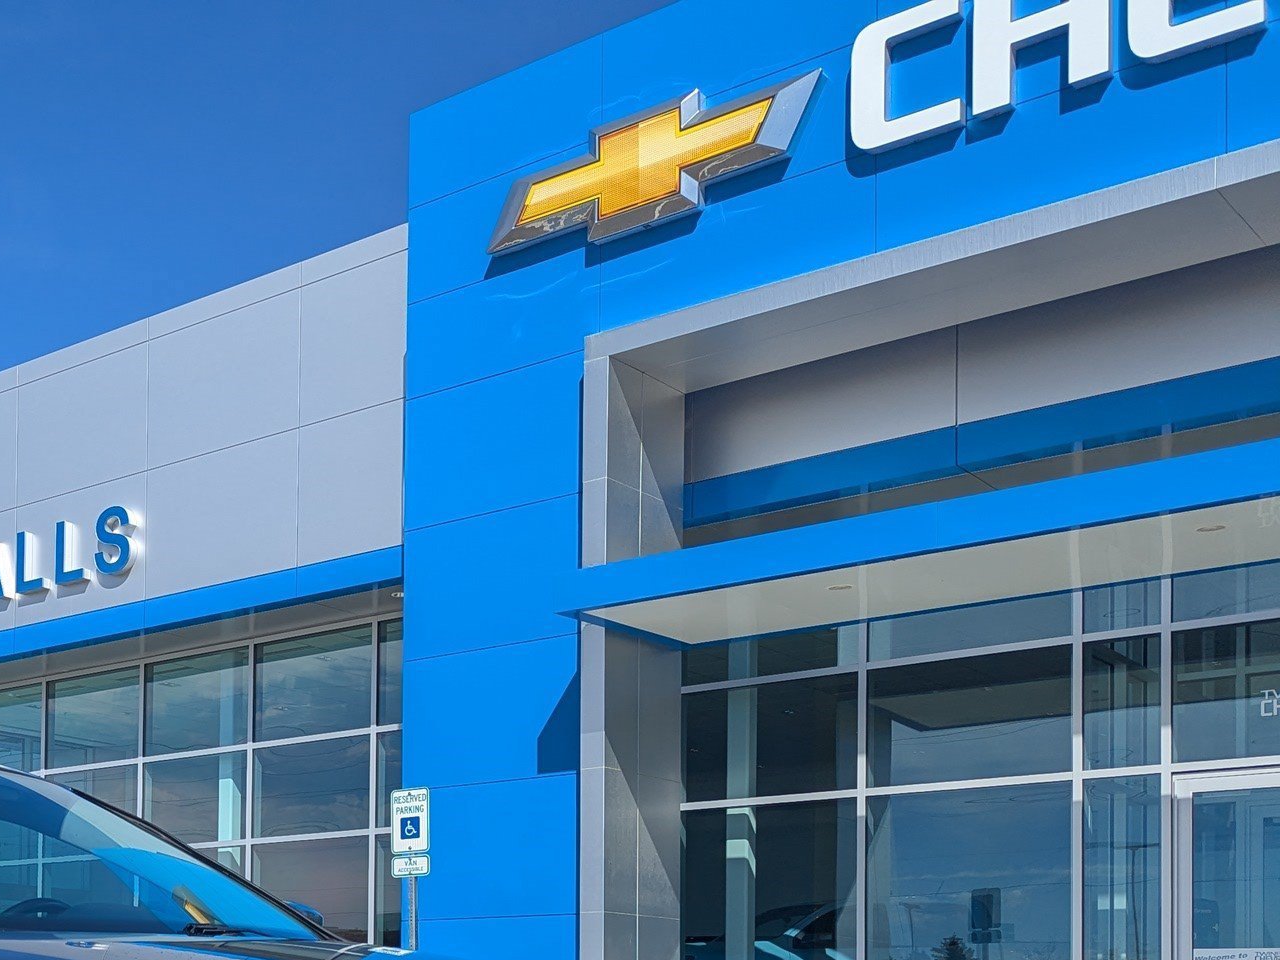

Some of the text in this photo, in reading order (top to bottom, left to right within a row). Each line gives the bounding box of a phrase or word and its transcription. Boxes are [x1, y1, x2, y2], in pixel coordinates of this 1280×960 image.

[393, 794, 426, 804] RESERVED
[396, 805, 424, 815] PARKING
[404, 859, 417, 867] VAN
